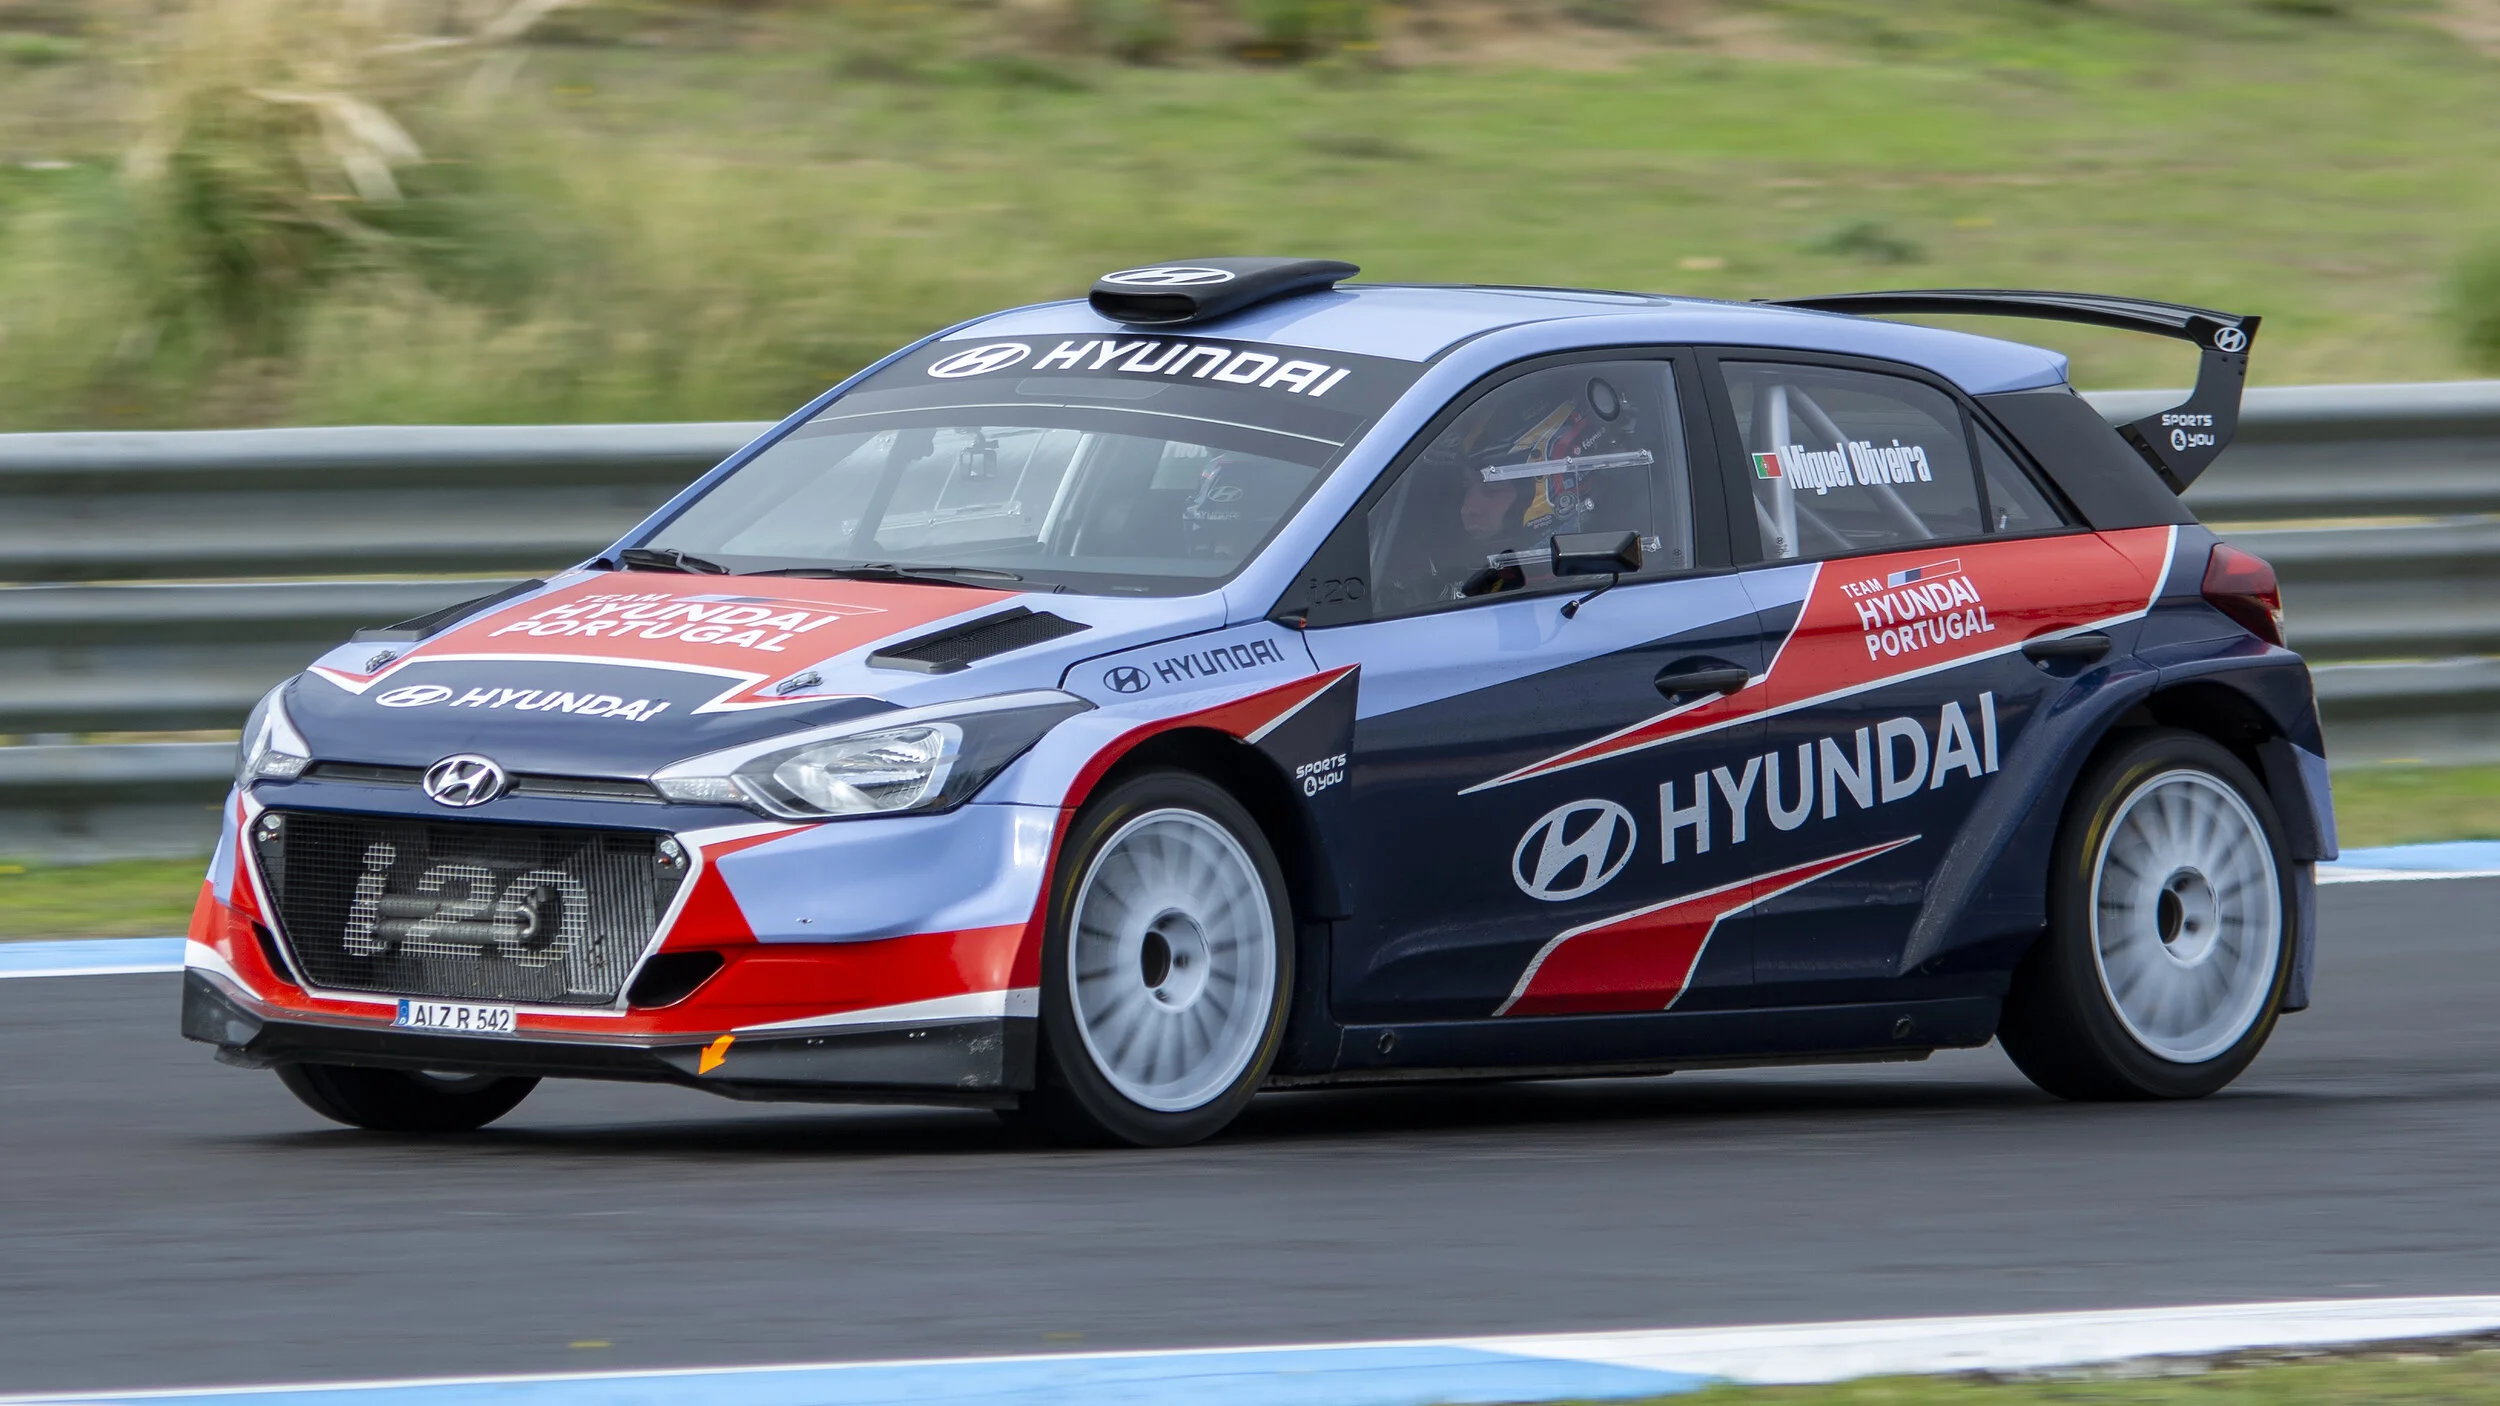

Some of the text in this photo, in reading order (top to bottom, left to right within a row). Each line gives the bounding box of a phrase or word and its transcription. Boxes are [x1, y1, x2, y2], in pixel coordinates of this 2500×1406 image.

[1031, 340, 1351, 398] HYUNDAI
[2161, 414, 2213, 427] SPORTS
[1780, 438, 1933, 496] Miguel Oliveira
[575, 593, 673, 604] TEAM
[1840, 578, 1884, 599] TEAM
[1854, 576, 1981, 632] HYUNDAI
[528, 602, 841, 633] HYUNDAI
[1865, 606, 1996, 662] PORTUGAL
[487, 620, 795, 653] PORTUGAL
[1152, 638, 1285, 684] HYUNDAI
[449, 687, 672, 723] HYUNDAI
[1295, 753, 1347, 779] SPORTS
[1659, 690, 2000, 865] HYUNDAI
[343, 842, 589, 968] i20
[456, 1007, 470, 1030] R
[476, 1009, 510, 1032] 542
